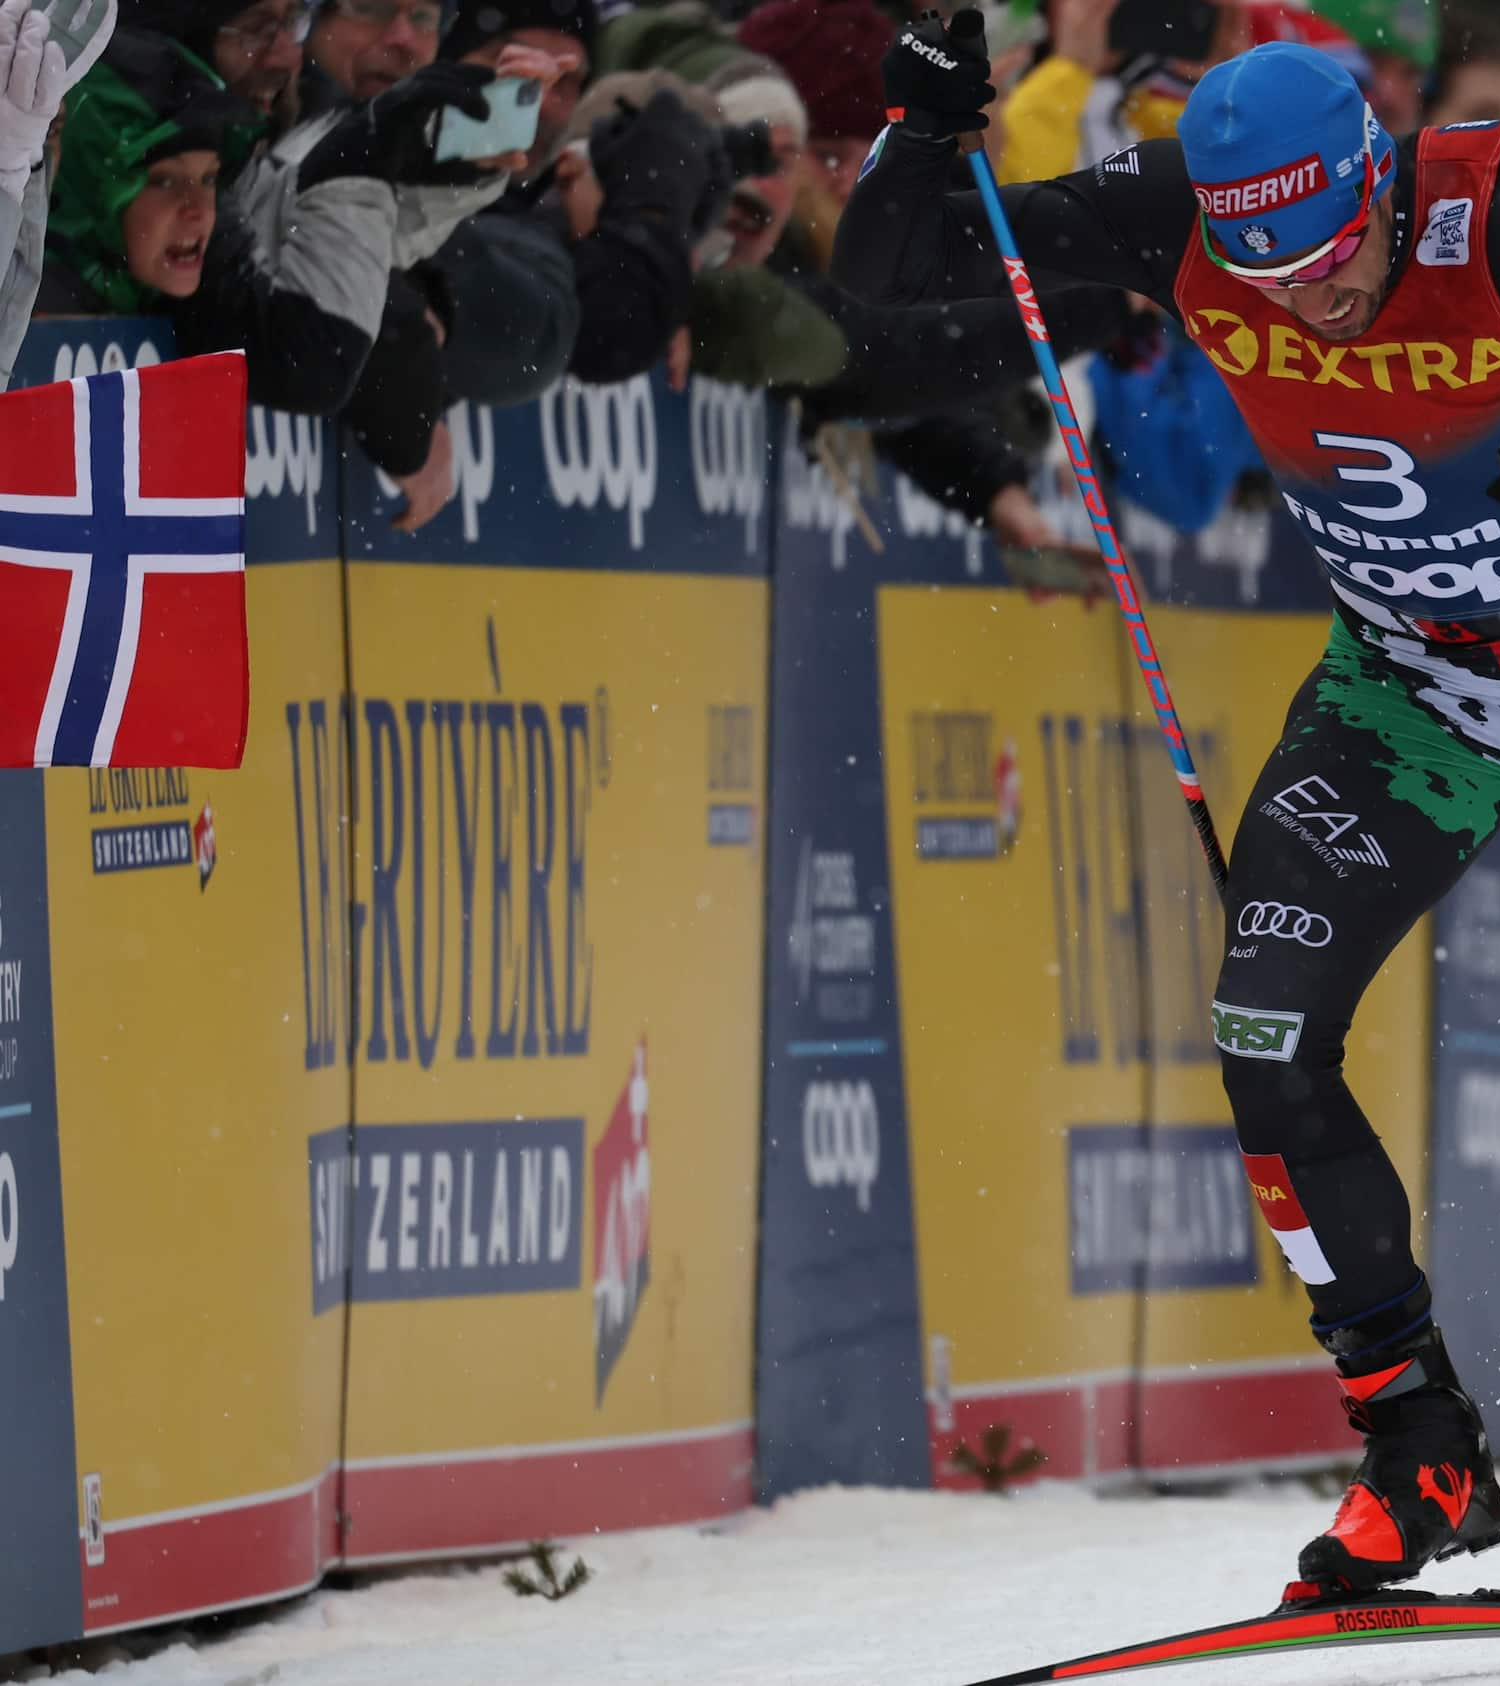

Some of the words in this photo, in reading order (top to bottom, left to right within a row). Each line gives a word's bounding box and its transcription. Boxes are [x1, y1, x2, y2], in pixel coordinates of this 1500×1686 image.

[1213, 160, 1320, 215] ENERVIT
[1314, 432, 1428, 522] 3
[1272, 774, 1391, 869] EA7
[94, 825, 189, 868] SWITZERLAND
[1228, 944, 1259, 959] Audi
[1334, 1608, 1422, 1633] ROSSIGNOL
